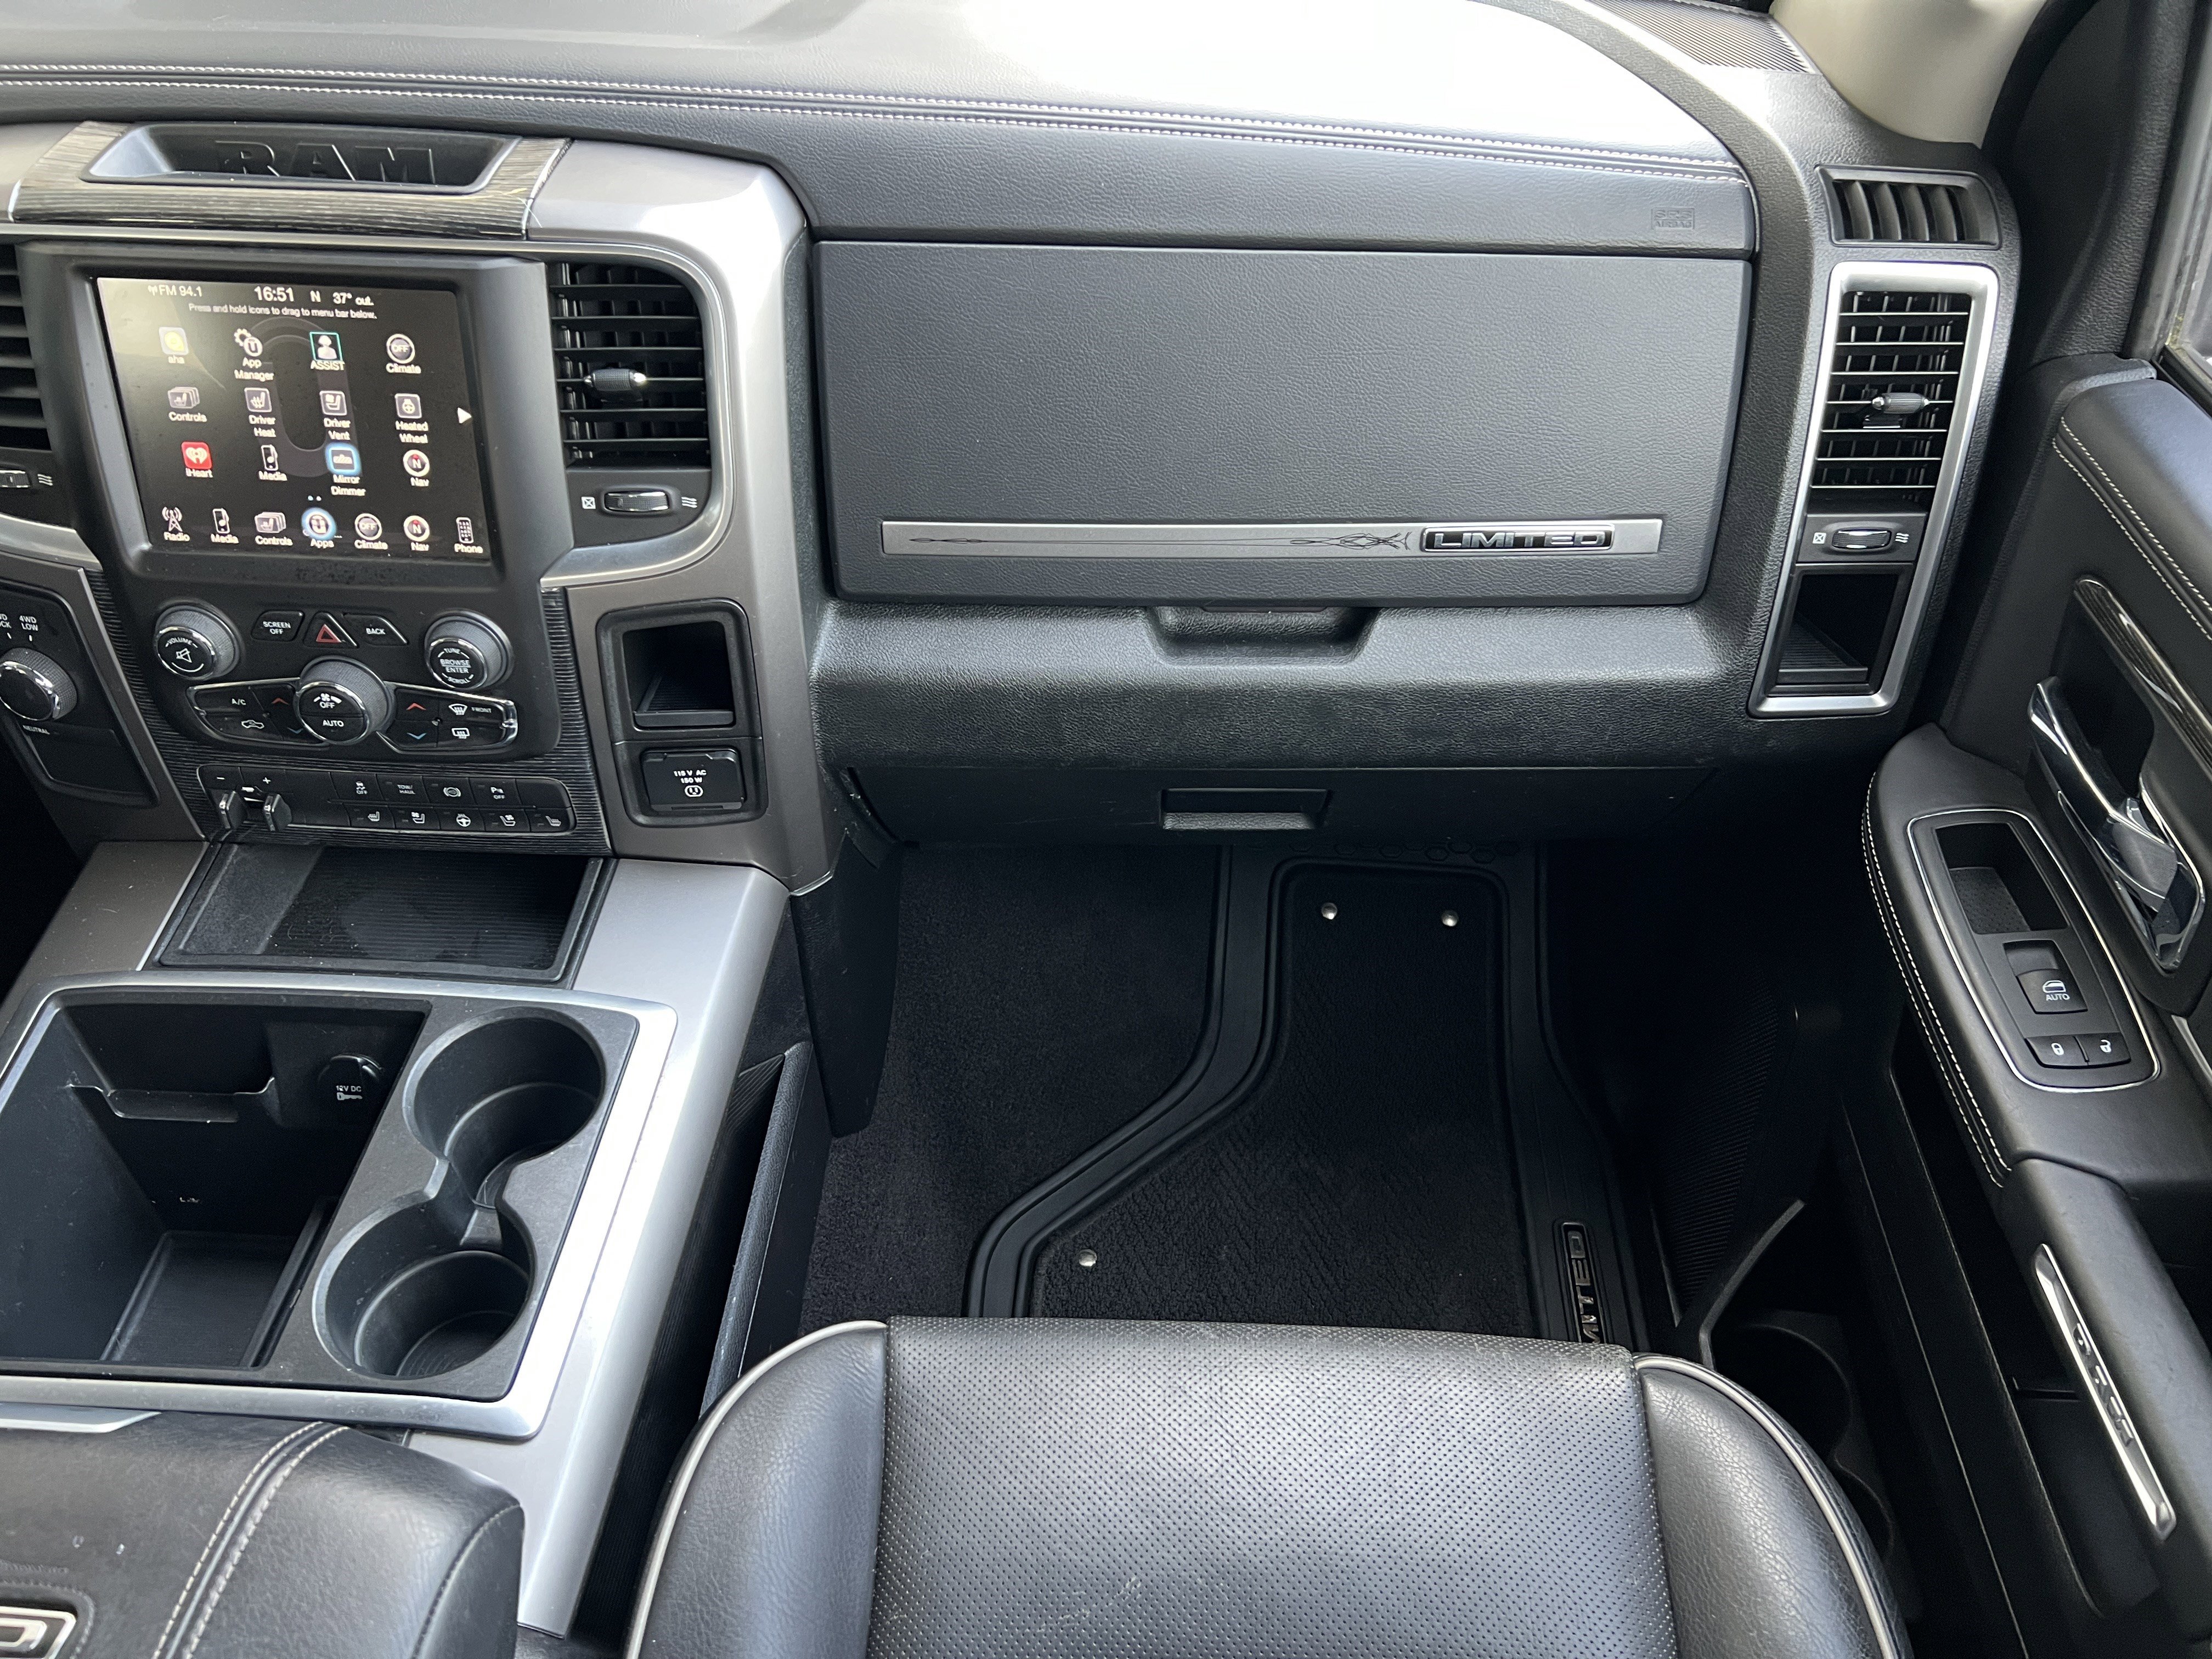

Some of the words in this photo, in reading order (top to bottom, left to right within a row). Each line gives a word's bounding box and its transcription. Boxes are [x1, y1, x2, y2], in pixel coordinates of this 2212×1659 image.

[214, 139, 437, 185] RAM
[159, 285, 177, 295] FM
[179, 286, 202, 297] 94.1
[255, 286, 294, 302] 16:51
[311, 291, 320, 302] N
[188, 303, 211, 312] Press
[229, 305, 247, 313] hold
[281, 307, 302, 317] drag
[335, 309, 348, 317] bar
[350, 309, 377, 319] below.
[242, 356, 262, 368] App
[311, 360, 345, 370] ASSIST
[386, 363, 422, 374] Climate
[234, 370, 274, 381] Manager
[168, 412, 207, 422] Controls
[249, 415, 276, 425] Driver
[324, 418, 351, 428] Driver
[396, 421, 428, 431] Heated
[254, 427, 276, 437] Heat
[329, 431, 350, 440] Vent
[399, 433, 428, 443] Wheel
[258, 471, 288, 481] Media
[333, 473, 360, 484] Mirror
[410, 476, 429, 486] Nav
[331, 486, 366, 496] Dimmer
[163, 532, 190, 541] Radio
[210, 534, 239, 544] Media
[255, 535, 293, 545] Controls
[1434, 531, 1605, 549] LIMITED
[311, 538, 334, 548] Apps
[354, 538, 388, 550] Climate
[411, 541, 429, 551] Nav
[454, 543, 483, 553] Phone
[19, 615, 37, 623] 4WD
[0, 620, 12, 629] CK
[21, 622, 38, 631] LOW
[167, 637, 193, 646] VOLUME
[439, 658, 471, 667] BROWSE
[447, 676, 471, 685] SCROLL
[319, 701, 336, 710] OFF
[23, 725, 50, 736] NEUTRAL
[1567, 1230, 1601, 1344] MITED
